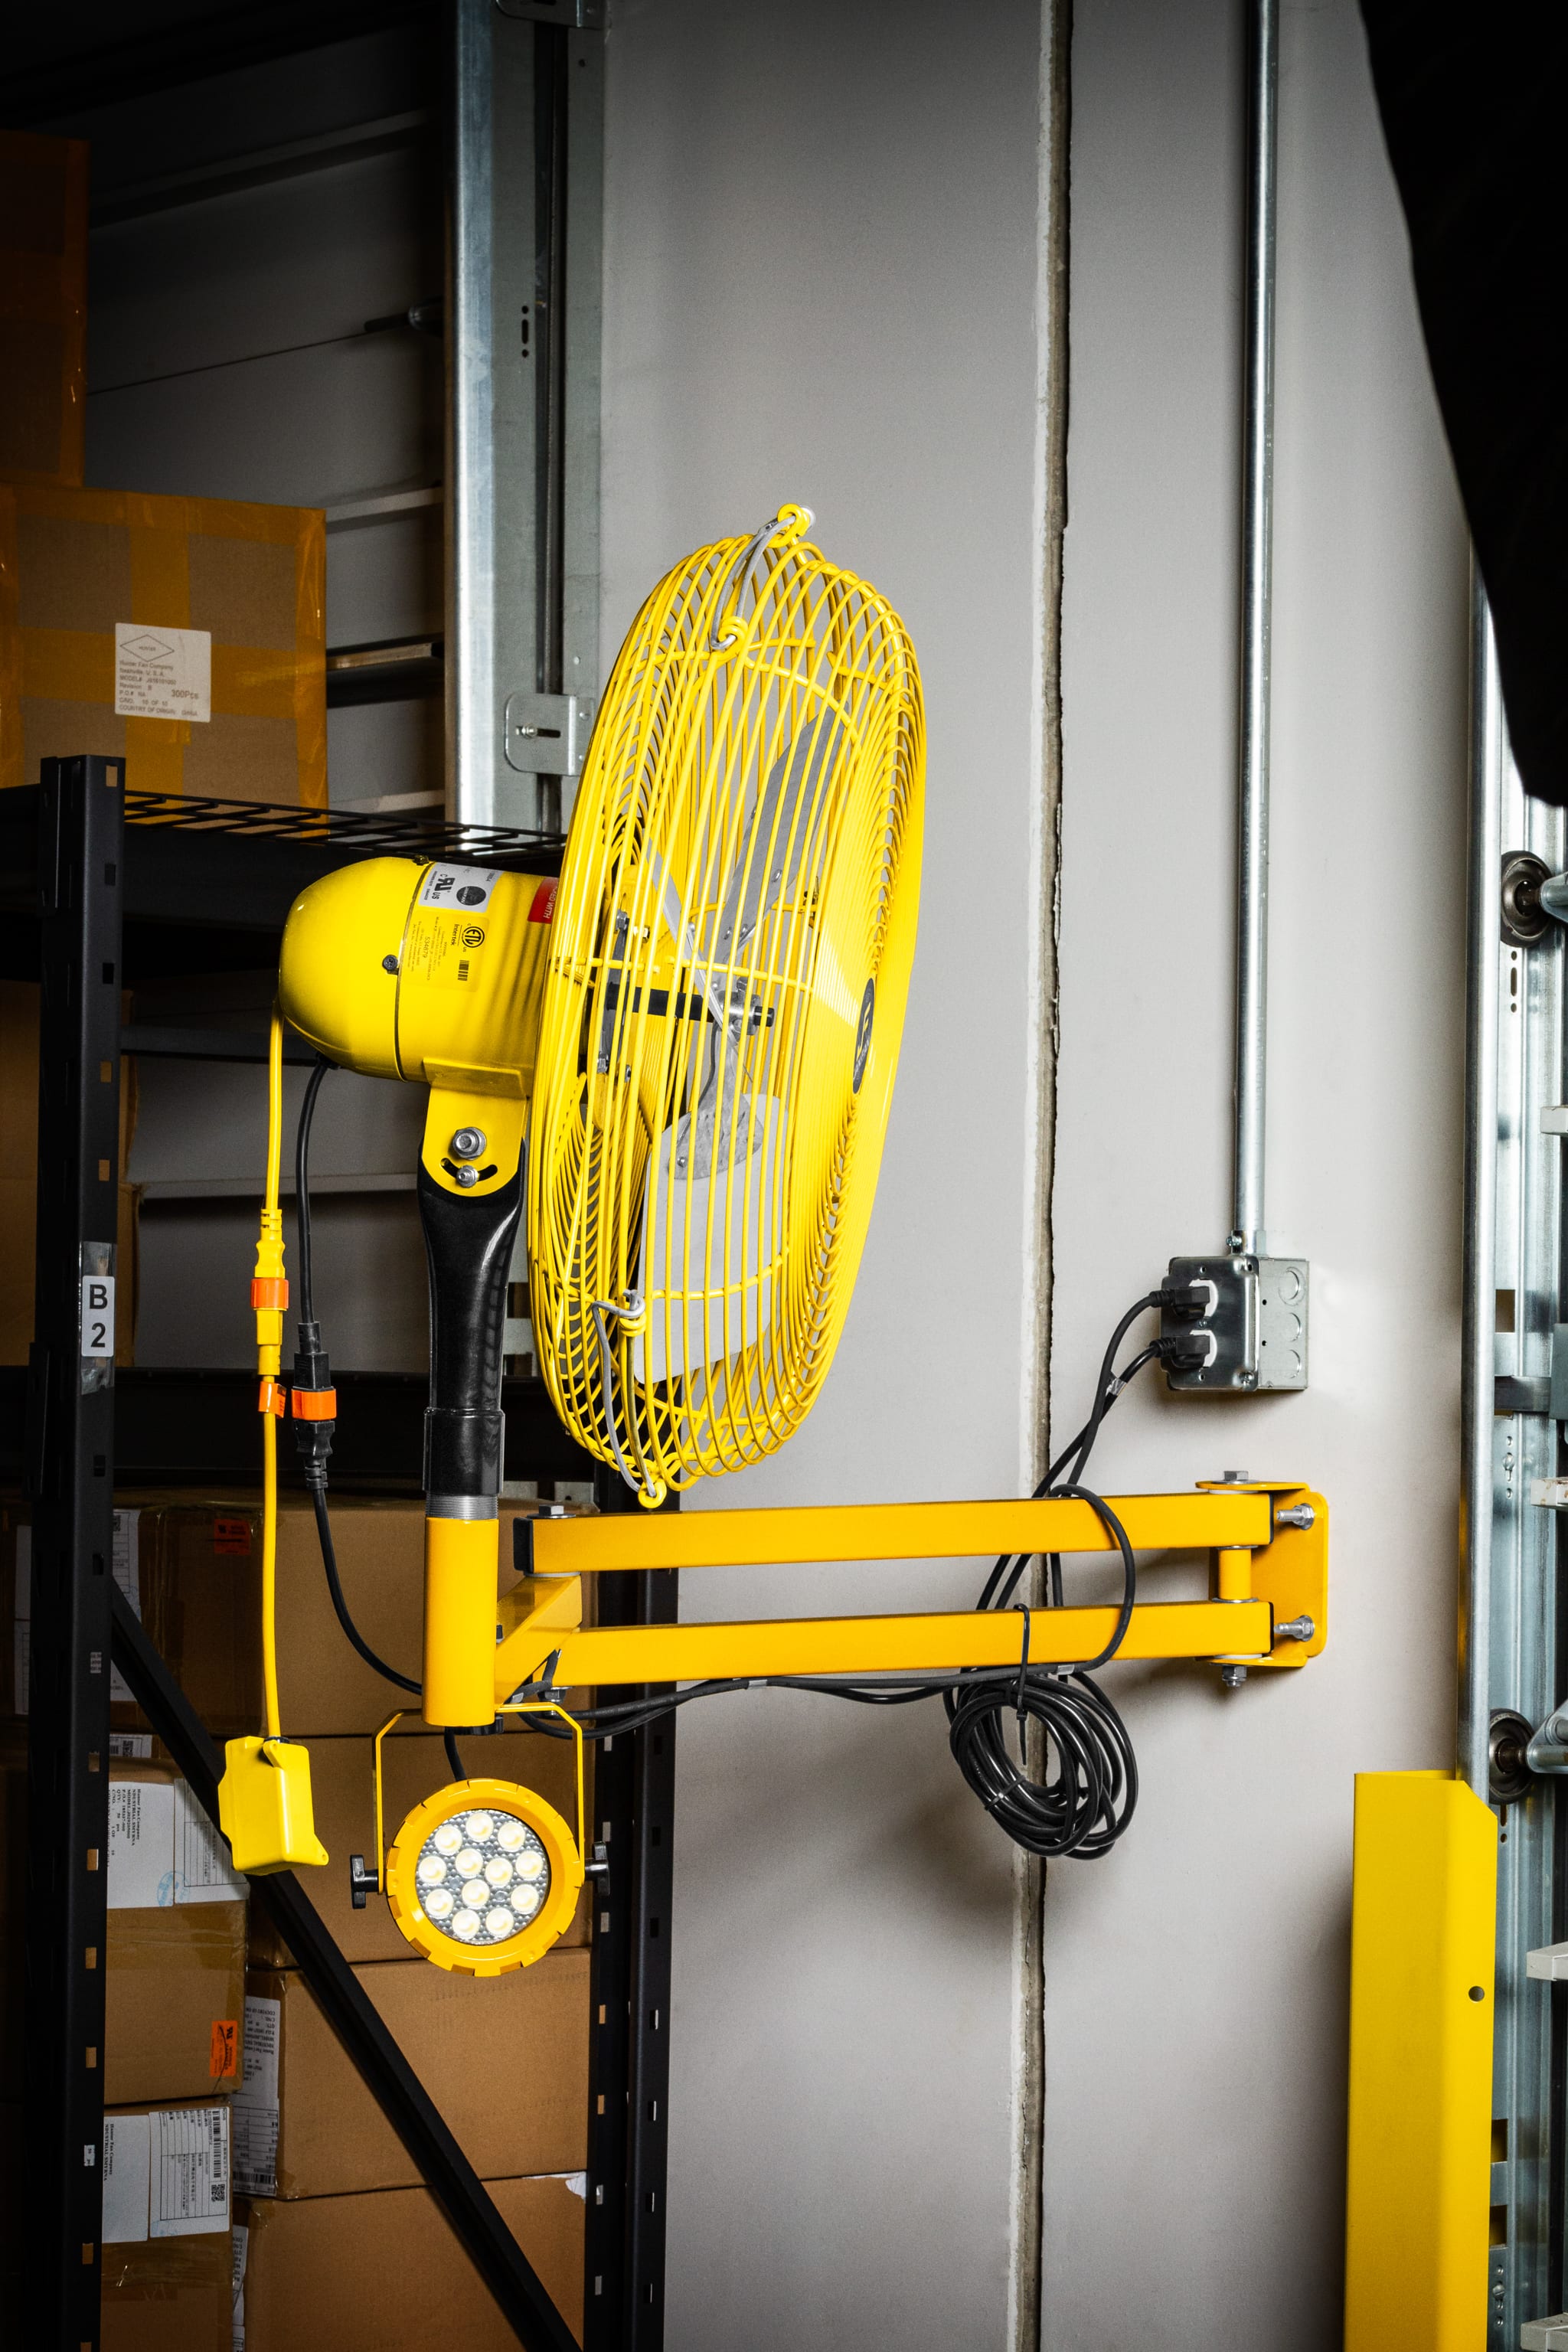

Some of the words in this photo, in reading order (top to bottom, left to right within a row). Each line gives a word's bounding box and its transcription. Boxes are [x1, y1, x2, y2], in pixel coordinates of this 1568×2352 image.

[432, 891, 441, 900] US
[542, 902, 554, 919] WITH
[450, 923, 459, 946] Intertek
[422, 936, 430, 959] 534879
[90, 1284, 108, 1310] B
[90, 1322, 106, 1348] 2
